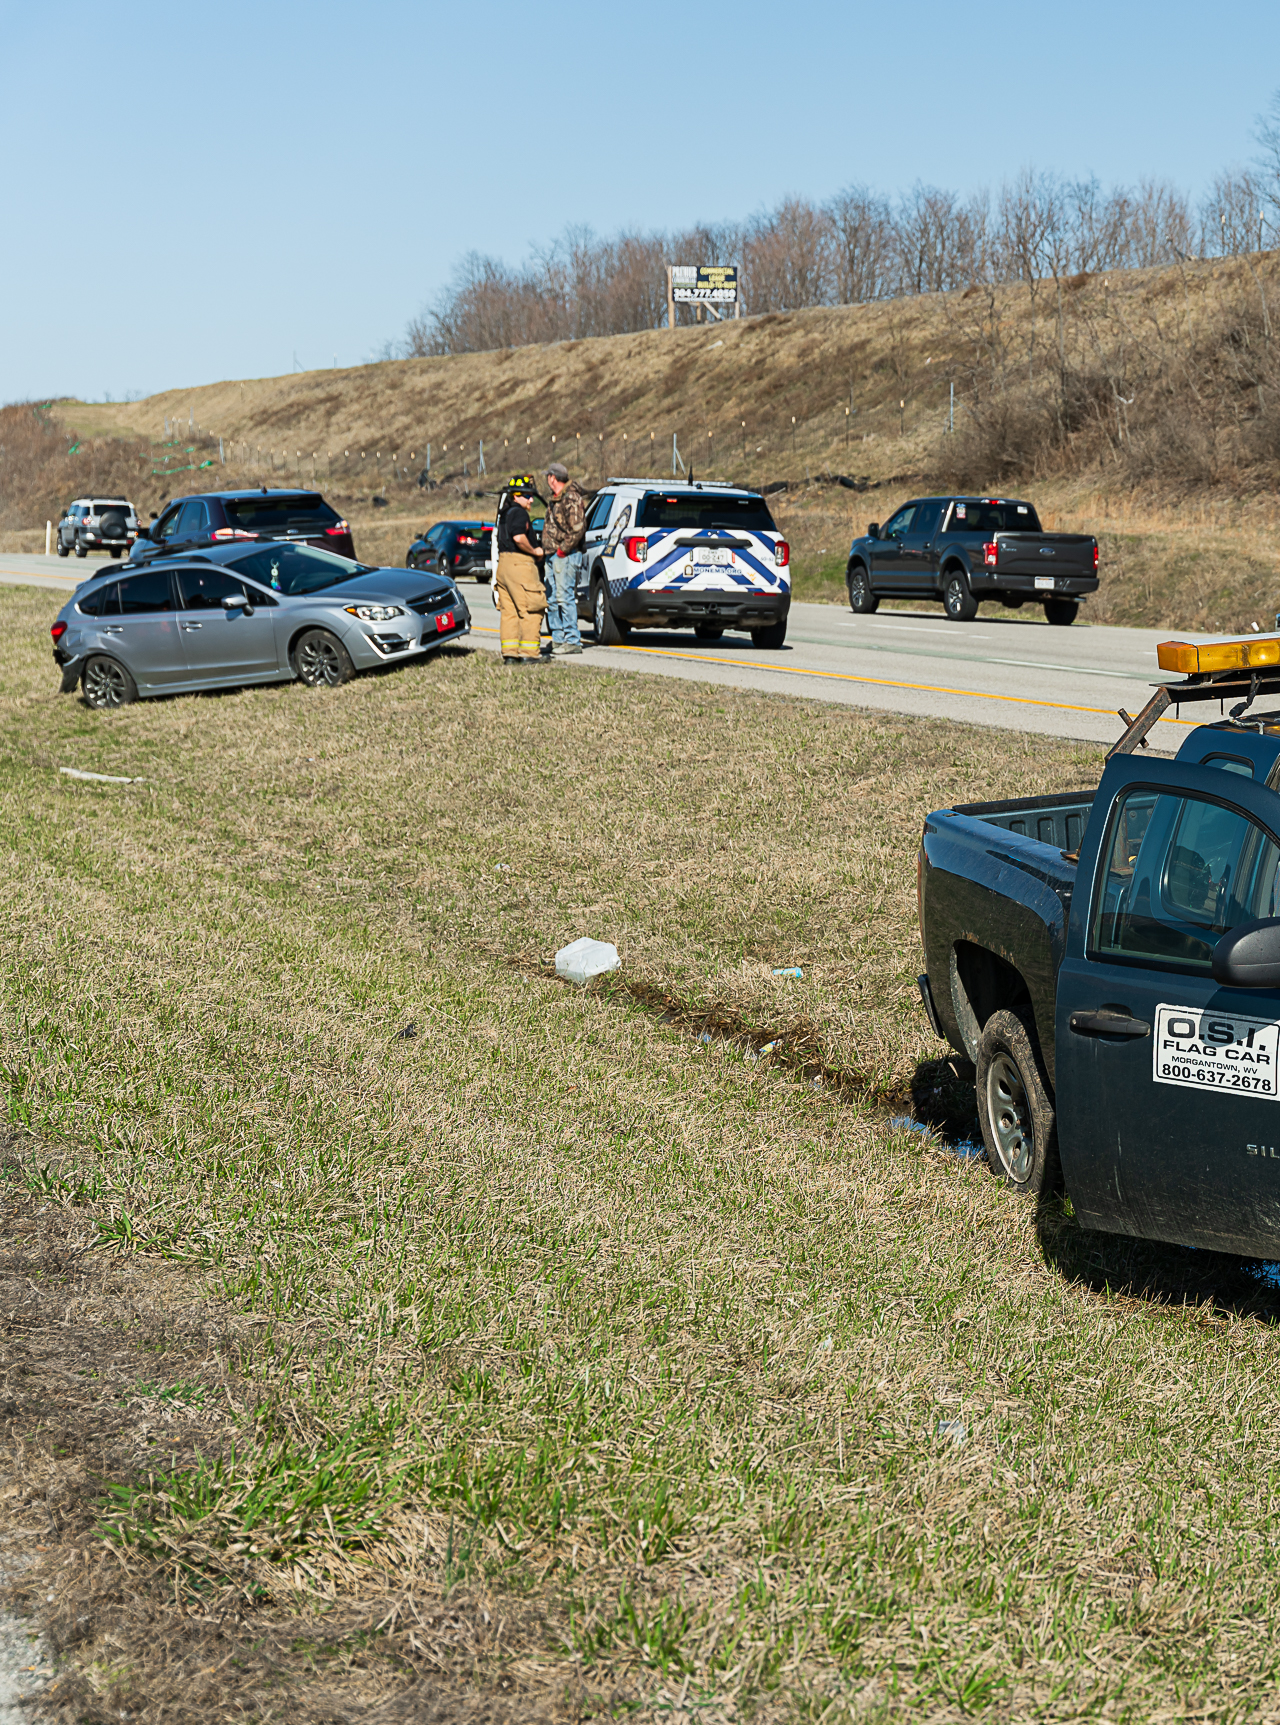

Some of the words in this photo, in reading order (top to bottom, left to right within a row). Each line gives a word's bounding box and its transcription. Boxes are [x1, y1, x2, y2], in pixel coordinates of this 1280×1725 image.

[1167, 1017, 1266, 1051] O.S.I.
[1163, 1039, 1217, 1057] FLAG
[1225, 1049, 1271, 1065] CAR
[1171, 1055, 1240, 1073] MORGANTOWN,
[1162, 1063, 1271, 1091] 800-637-2678
